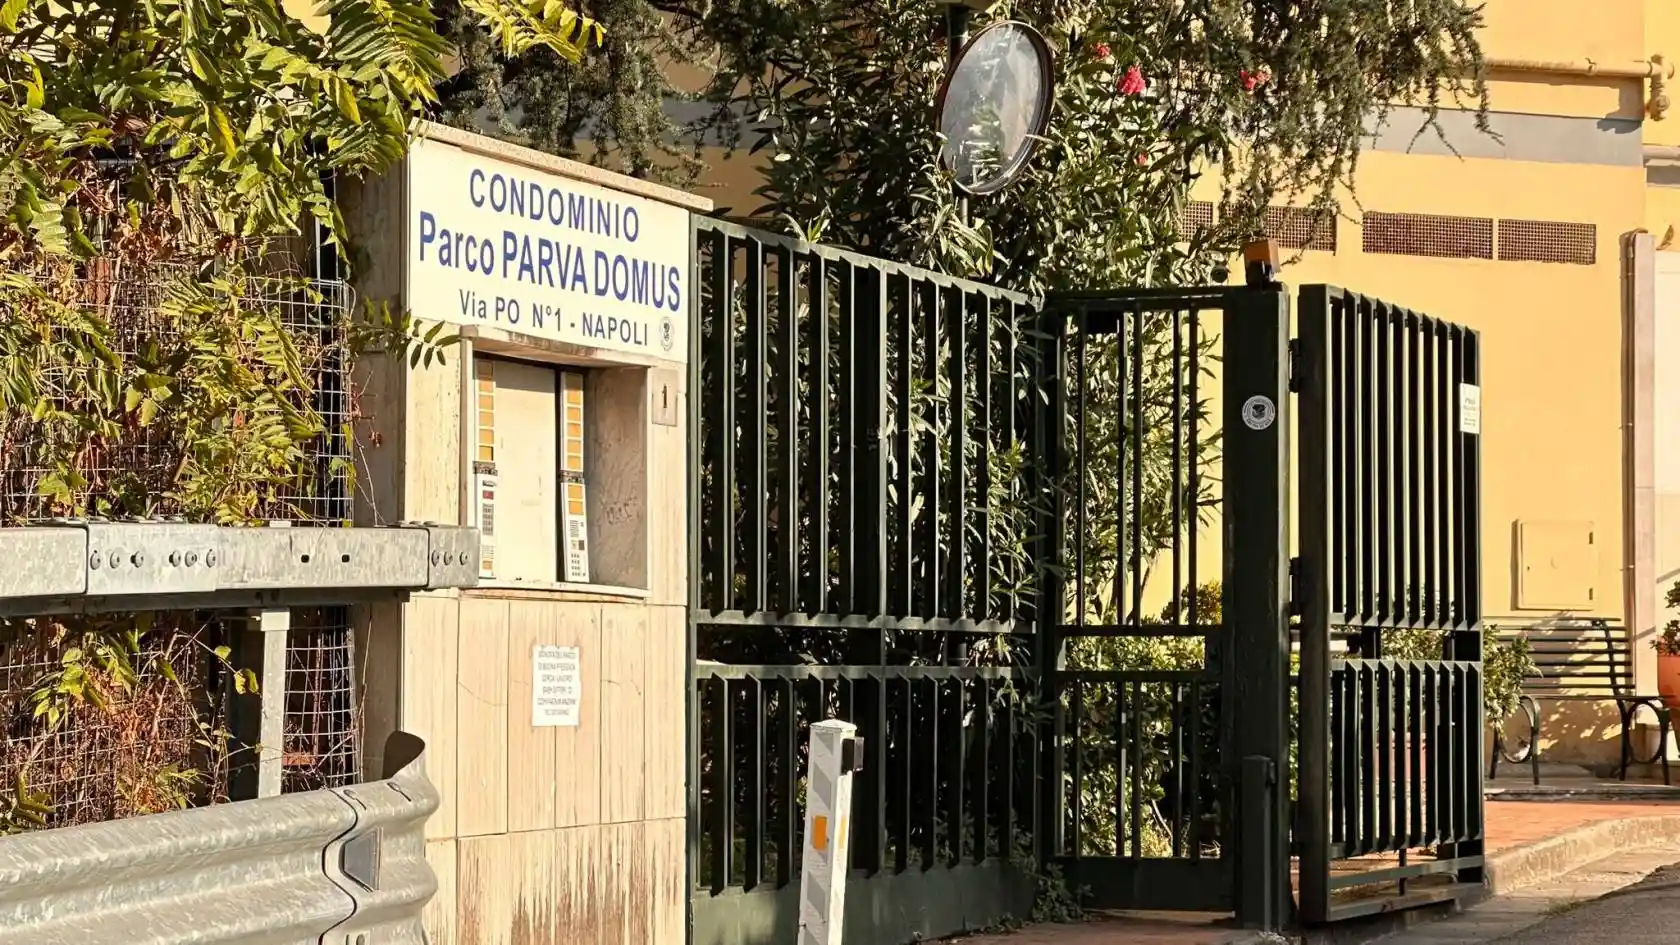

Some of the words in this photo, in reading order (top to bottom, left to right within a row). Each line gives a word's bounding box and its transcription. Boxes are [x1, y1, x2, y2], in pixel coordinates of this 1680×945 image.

[470, 168, 639, 243] CONDOMINIO
[419, 210, 495, 276] Parco
[502, 230, 589, 295] PARVA
[594, 249, 681, 312] DOMUS
[459, 288, 487, 319] Via
[495, 296, 520, 324] PO
[532, 303, 562, 332] N°1
[582, 311, 649, 346] NAPOLI
[661, 383, 668, 409] 1
